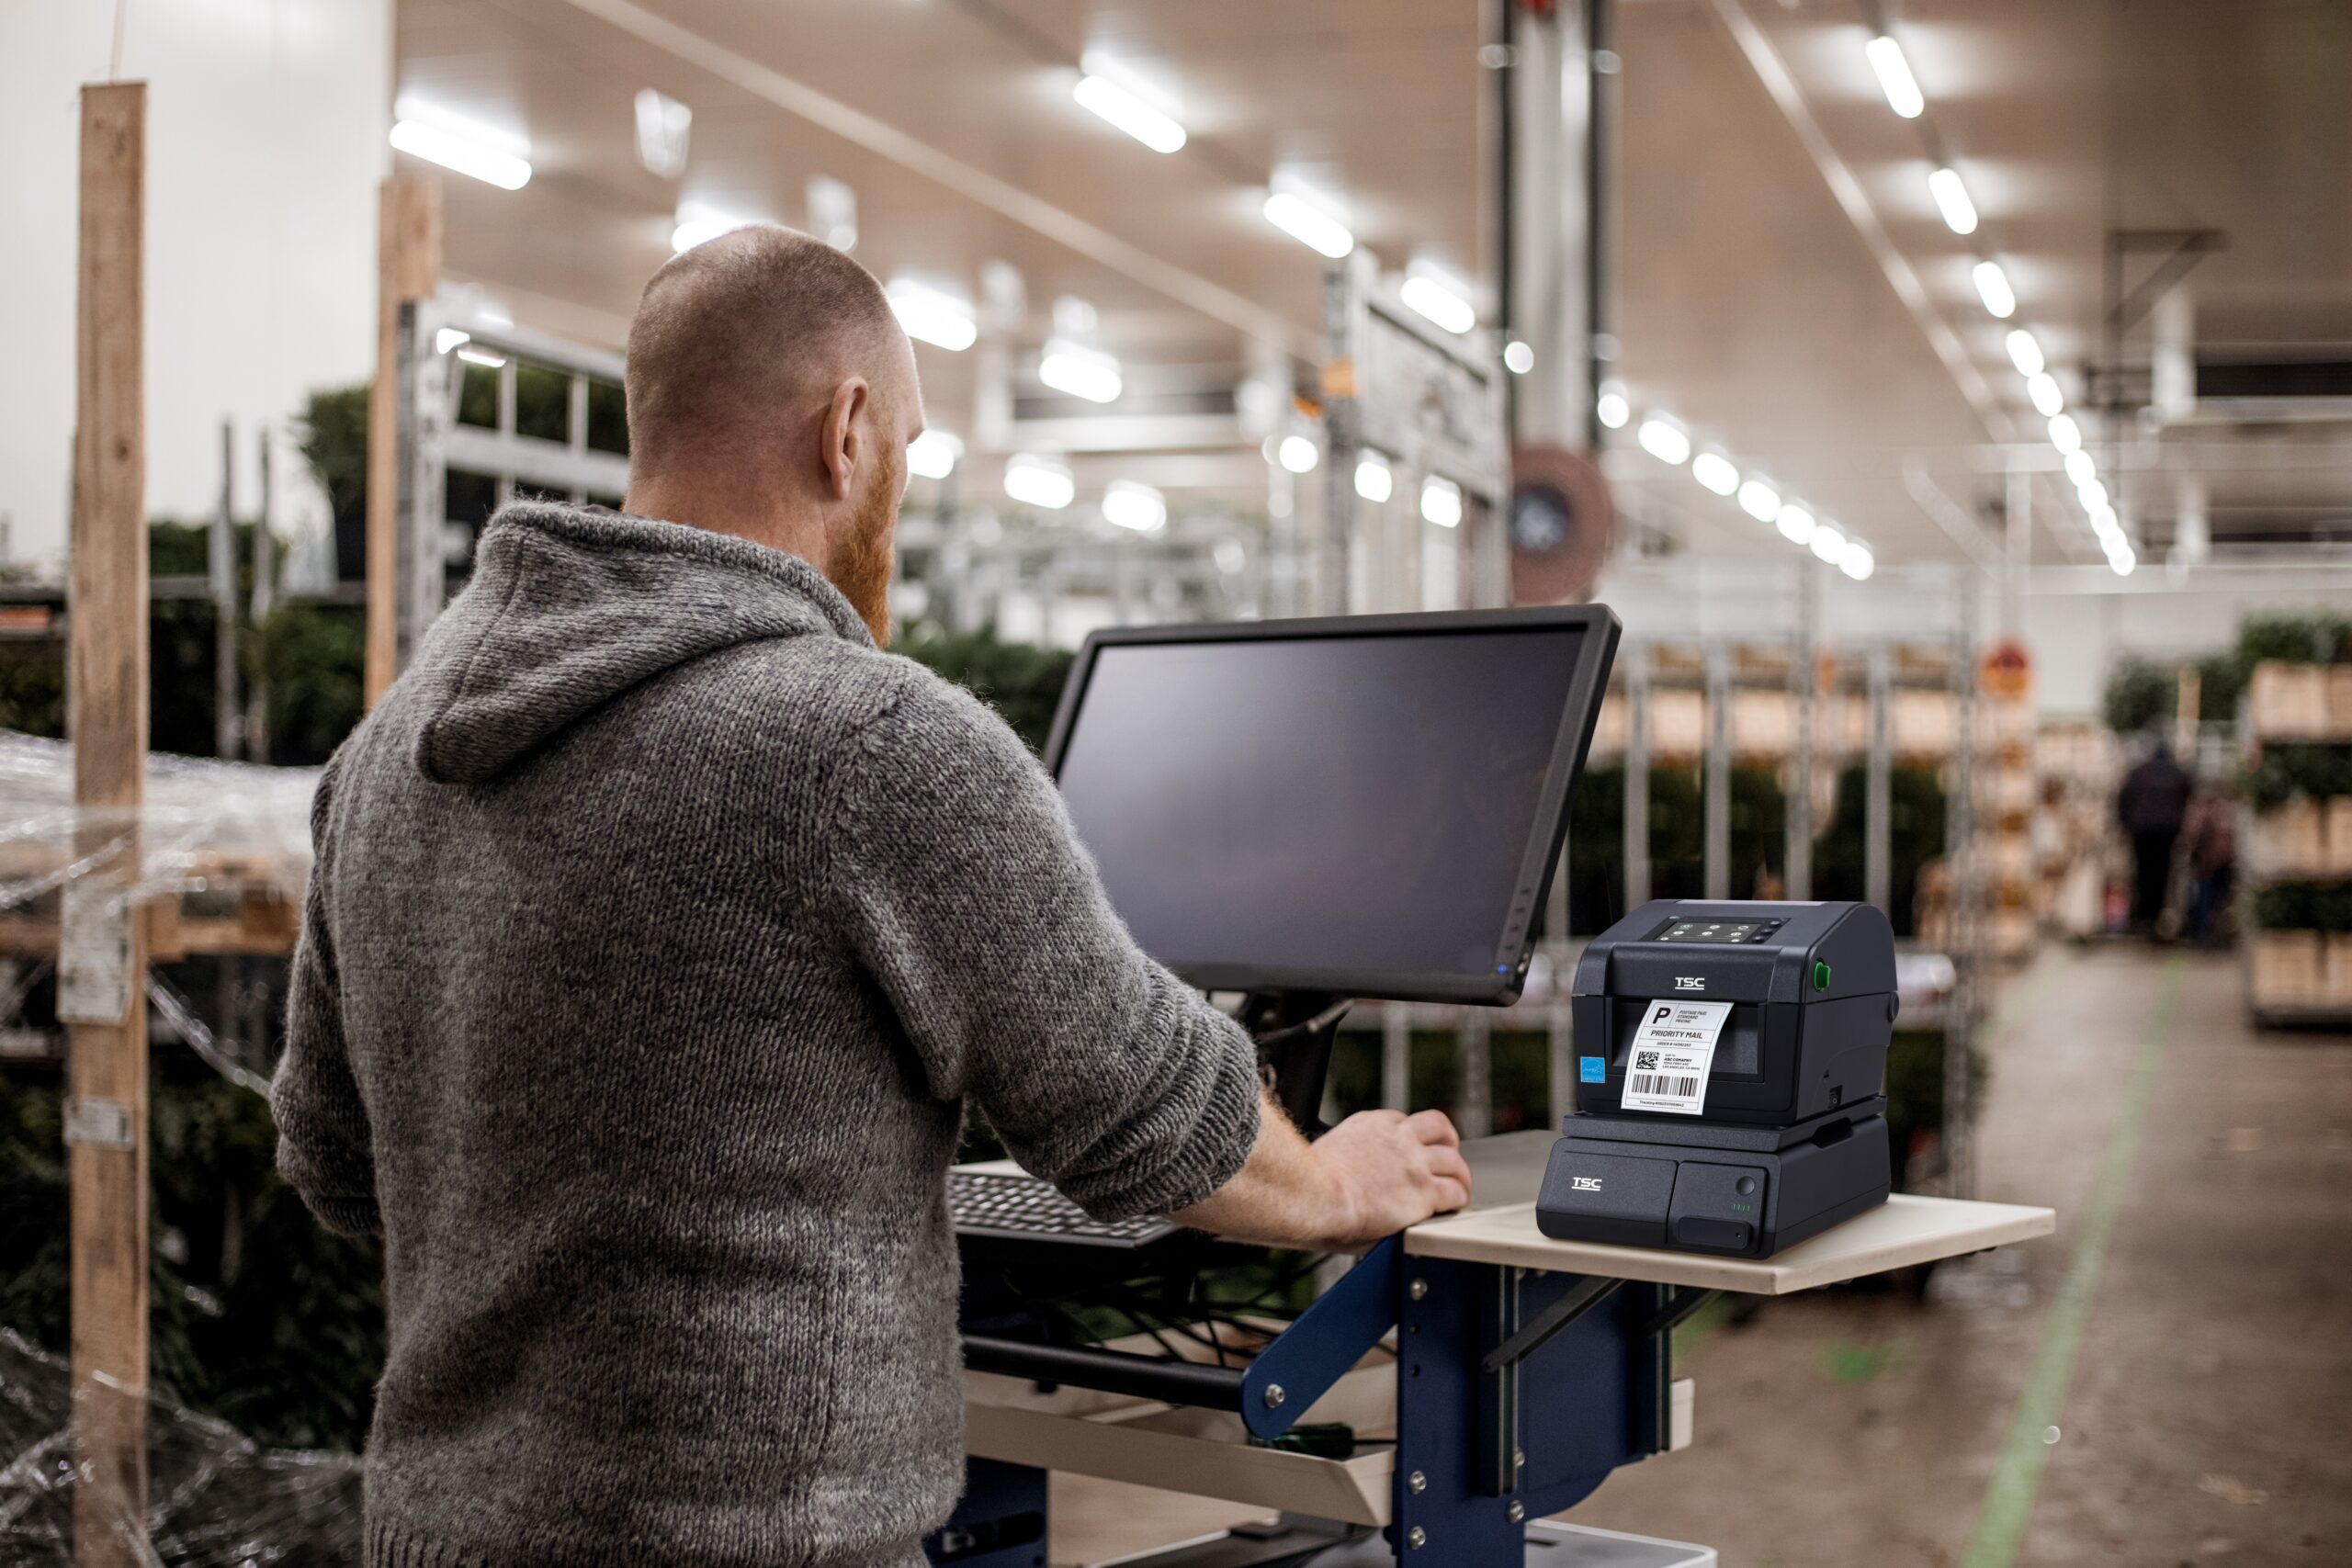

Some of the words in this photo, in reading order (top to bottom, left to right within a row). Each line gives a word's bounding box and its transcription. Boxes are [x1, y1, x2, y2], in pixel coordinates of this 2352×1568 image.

[1675, 977, 1705, 988] TSC
[1652, 1007, 1671, 1024] P
[1650, 1030, 1685, 1038] PRIORITY
[1572, 1177, 1602, 1189] TSC
